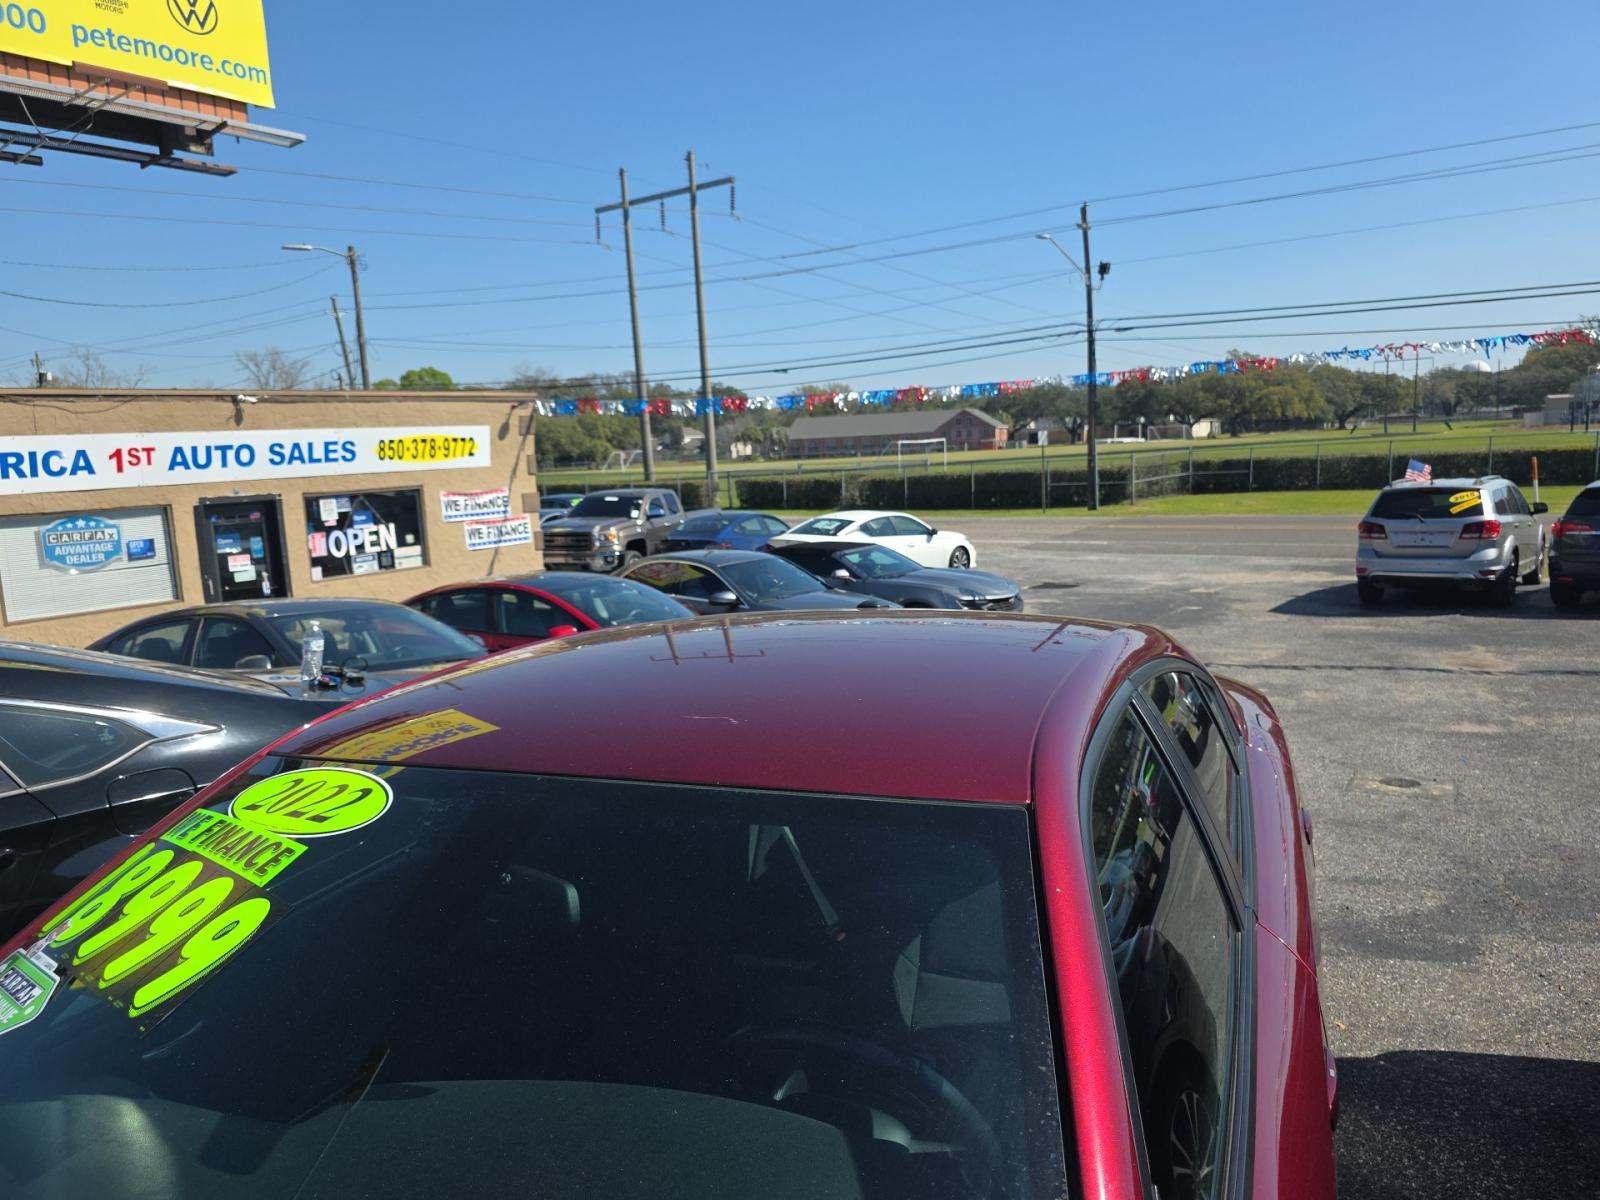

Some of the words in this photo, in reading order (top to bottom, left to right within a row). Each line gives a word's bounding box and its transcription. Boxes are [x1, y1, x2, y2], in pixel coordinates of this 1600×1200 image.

[0, 3, 46, 34] 00
[72, 23, 267, 85] petemoore.com
[109, 447, 156, 473] 1ST
[168, 443, 256, 471] AUTO
[268, 440, 357, 466] SALES
[445, 499, 461, 512] WE
[464, 496, 509, 511] FINANCE
[49, 531, 115, 543] CARFAX
[328, 522, 398, 558] OPEN
[467, 527, 484, 540] WE
[487, 522, 529, 539] FINANCE
[55, 542, 114, 555] ADVANTAGE
[66, 553, 105, 564] DEALER
[241, 778, 373, 823] 2022
[166, 811, 215, 840] WE
[189, 818, 297, 877] FINANCE
[37, 842, 272, 1018] 18999
